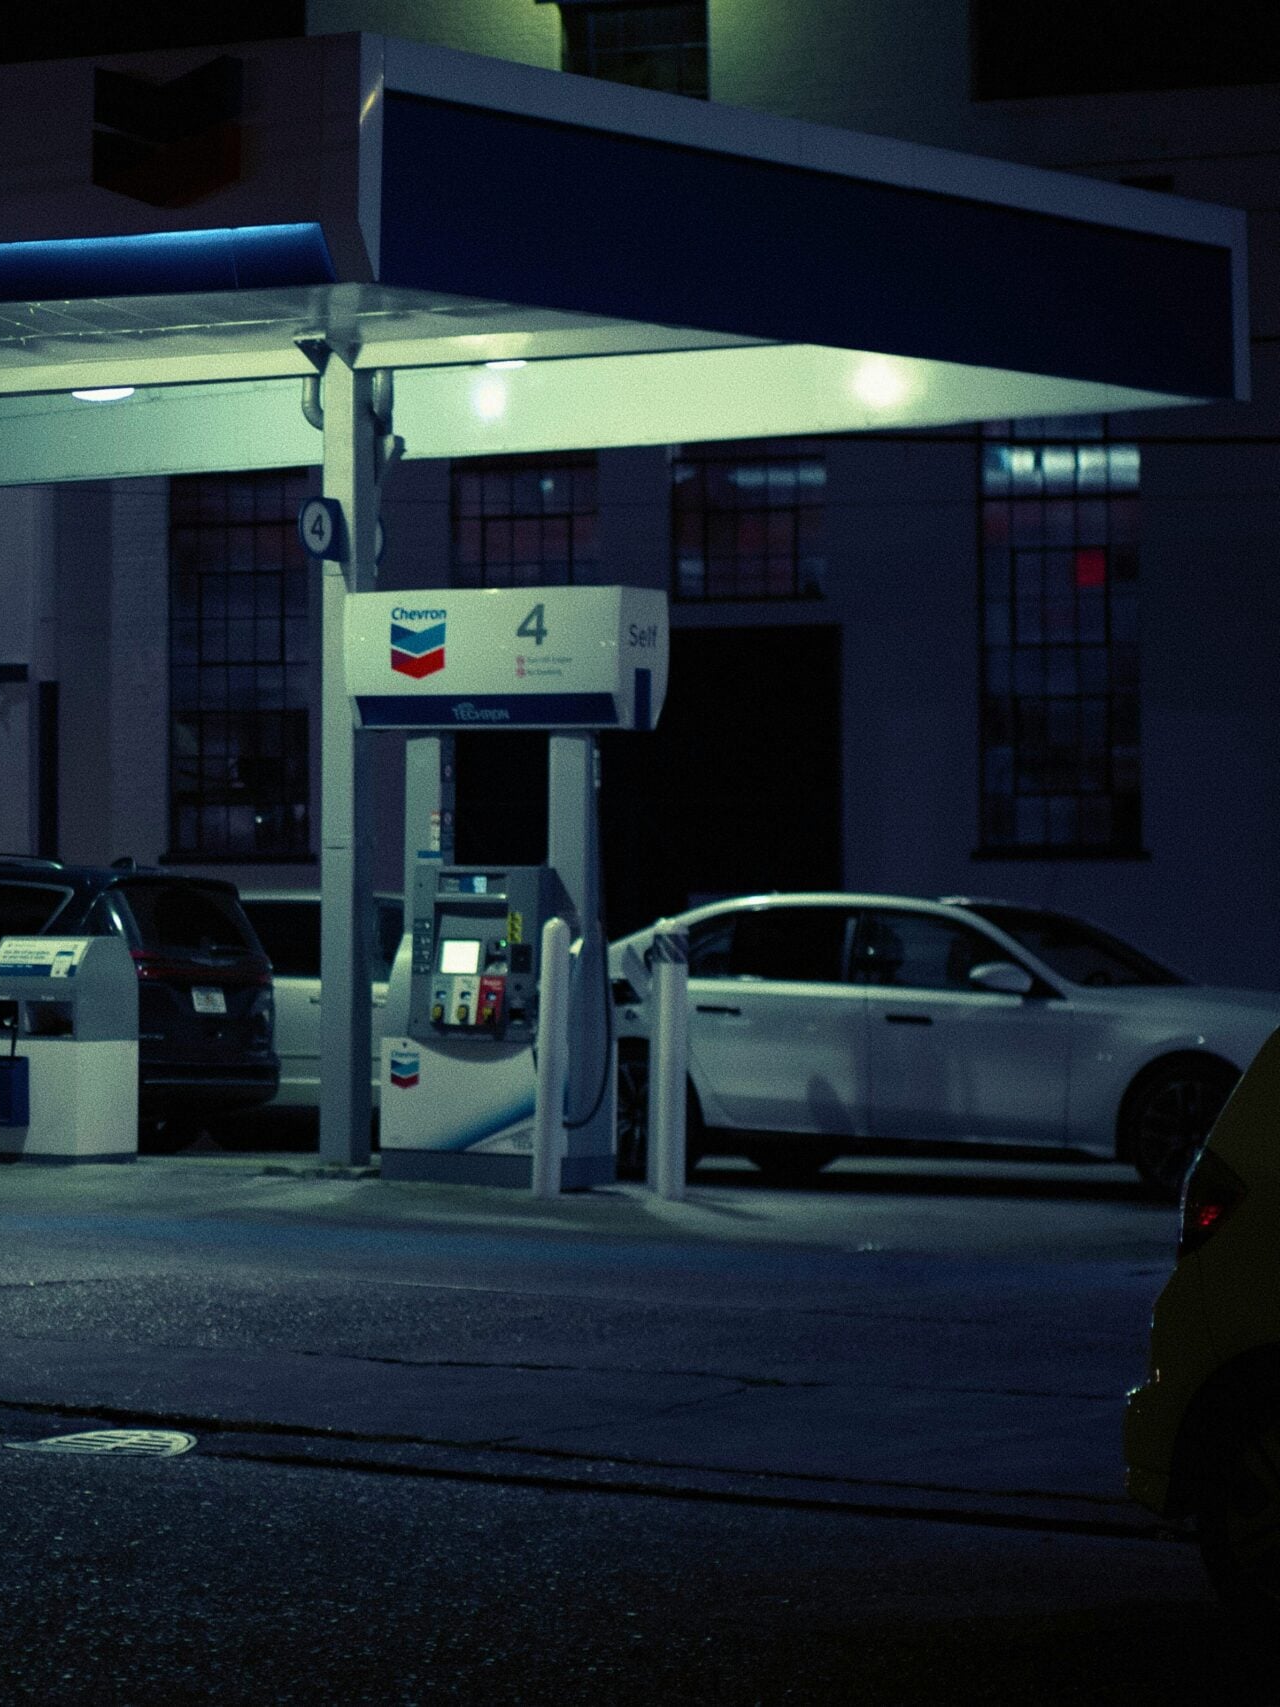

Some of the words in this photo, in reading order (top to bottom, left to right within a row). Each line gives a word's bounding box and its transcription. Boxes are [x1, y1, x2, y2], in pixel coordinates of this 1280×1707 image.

[310, 513, 325, 541] 4
[391, 607, 447, 620] Chevron
[516, 603, 548, 645] 4
[629, 624, 658, 647] Self
